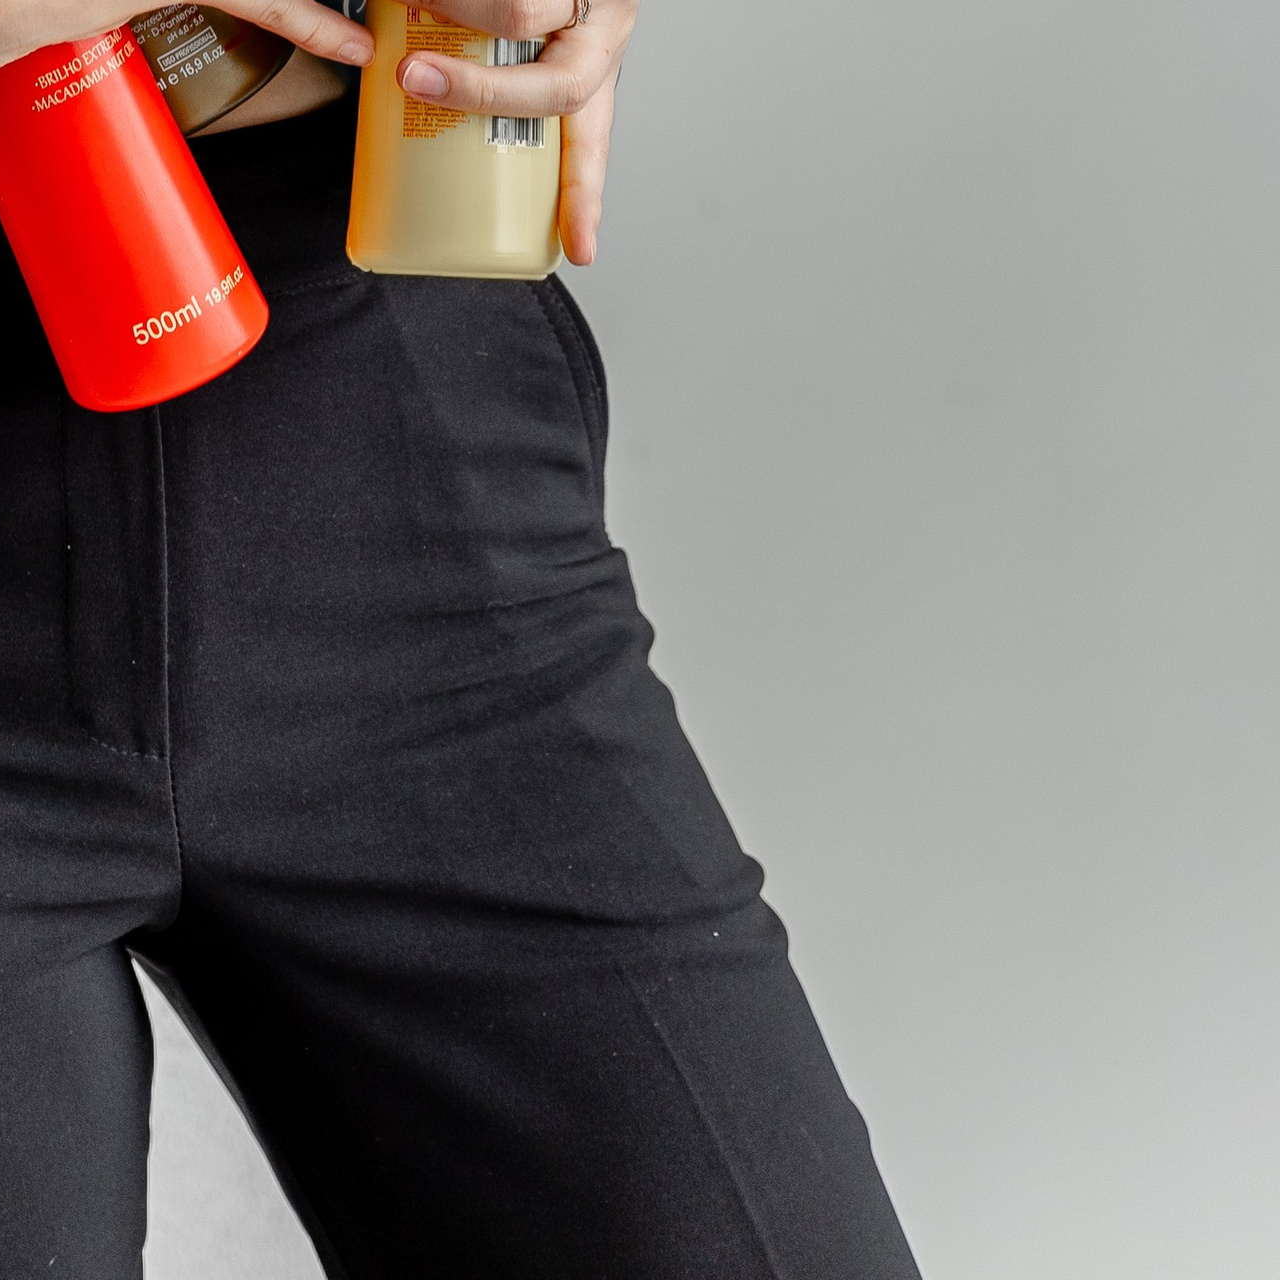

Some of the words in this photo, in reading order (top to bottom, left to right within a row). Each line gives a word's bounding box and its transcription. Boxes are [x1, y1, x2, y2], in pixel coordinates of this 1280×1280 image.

[106, 49, 126, 73] NUT
[180, 57, 203, 79] 16,9
[132, 295, 202, 346] 500ml
